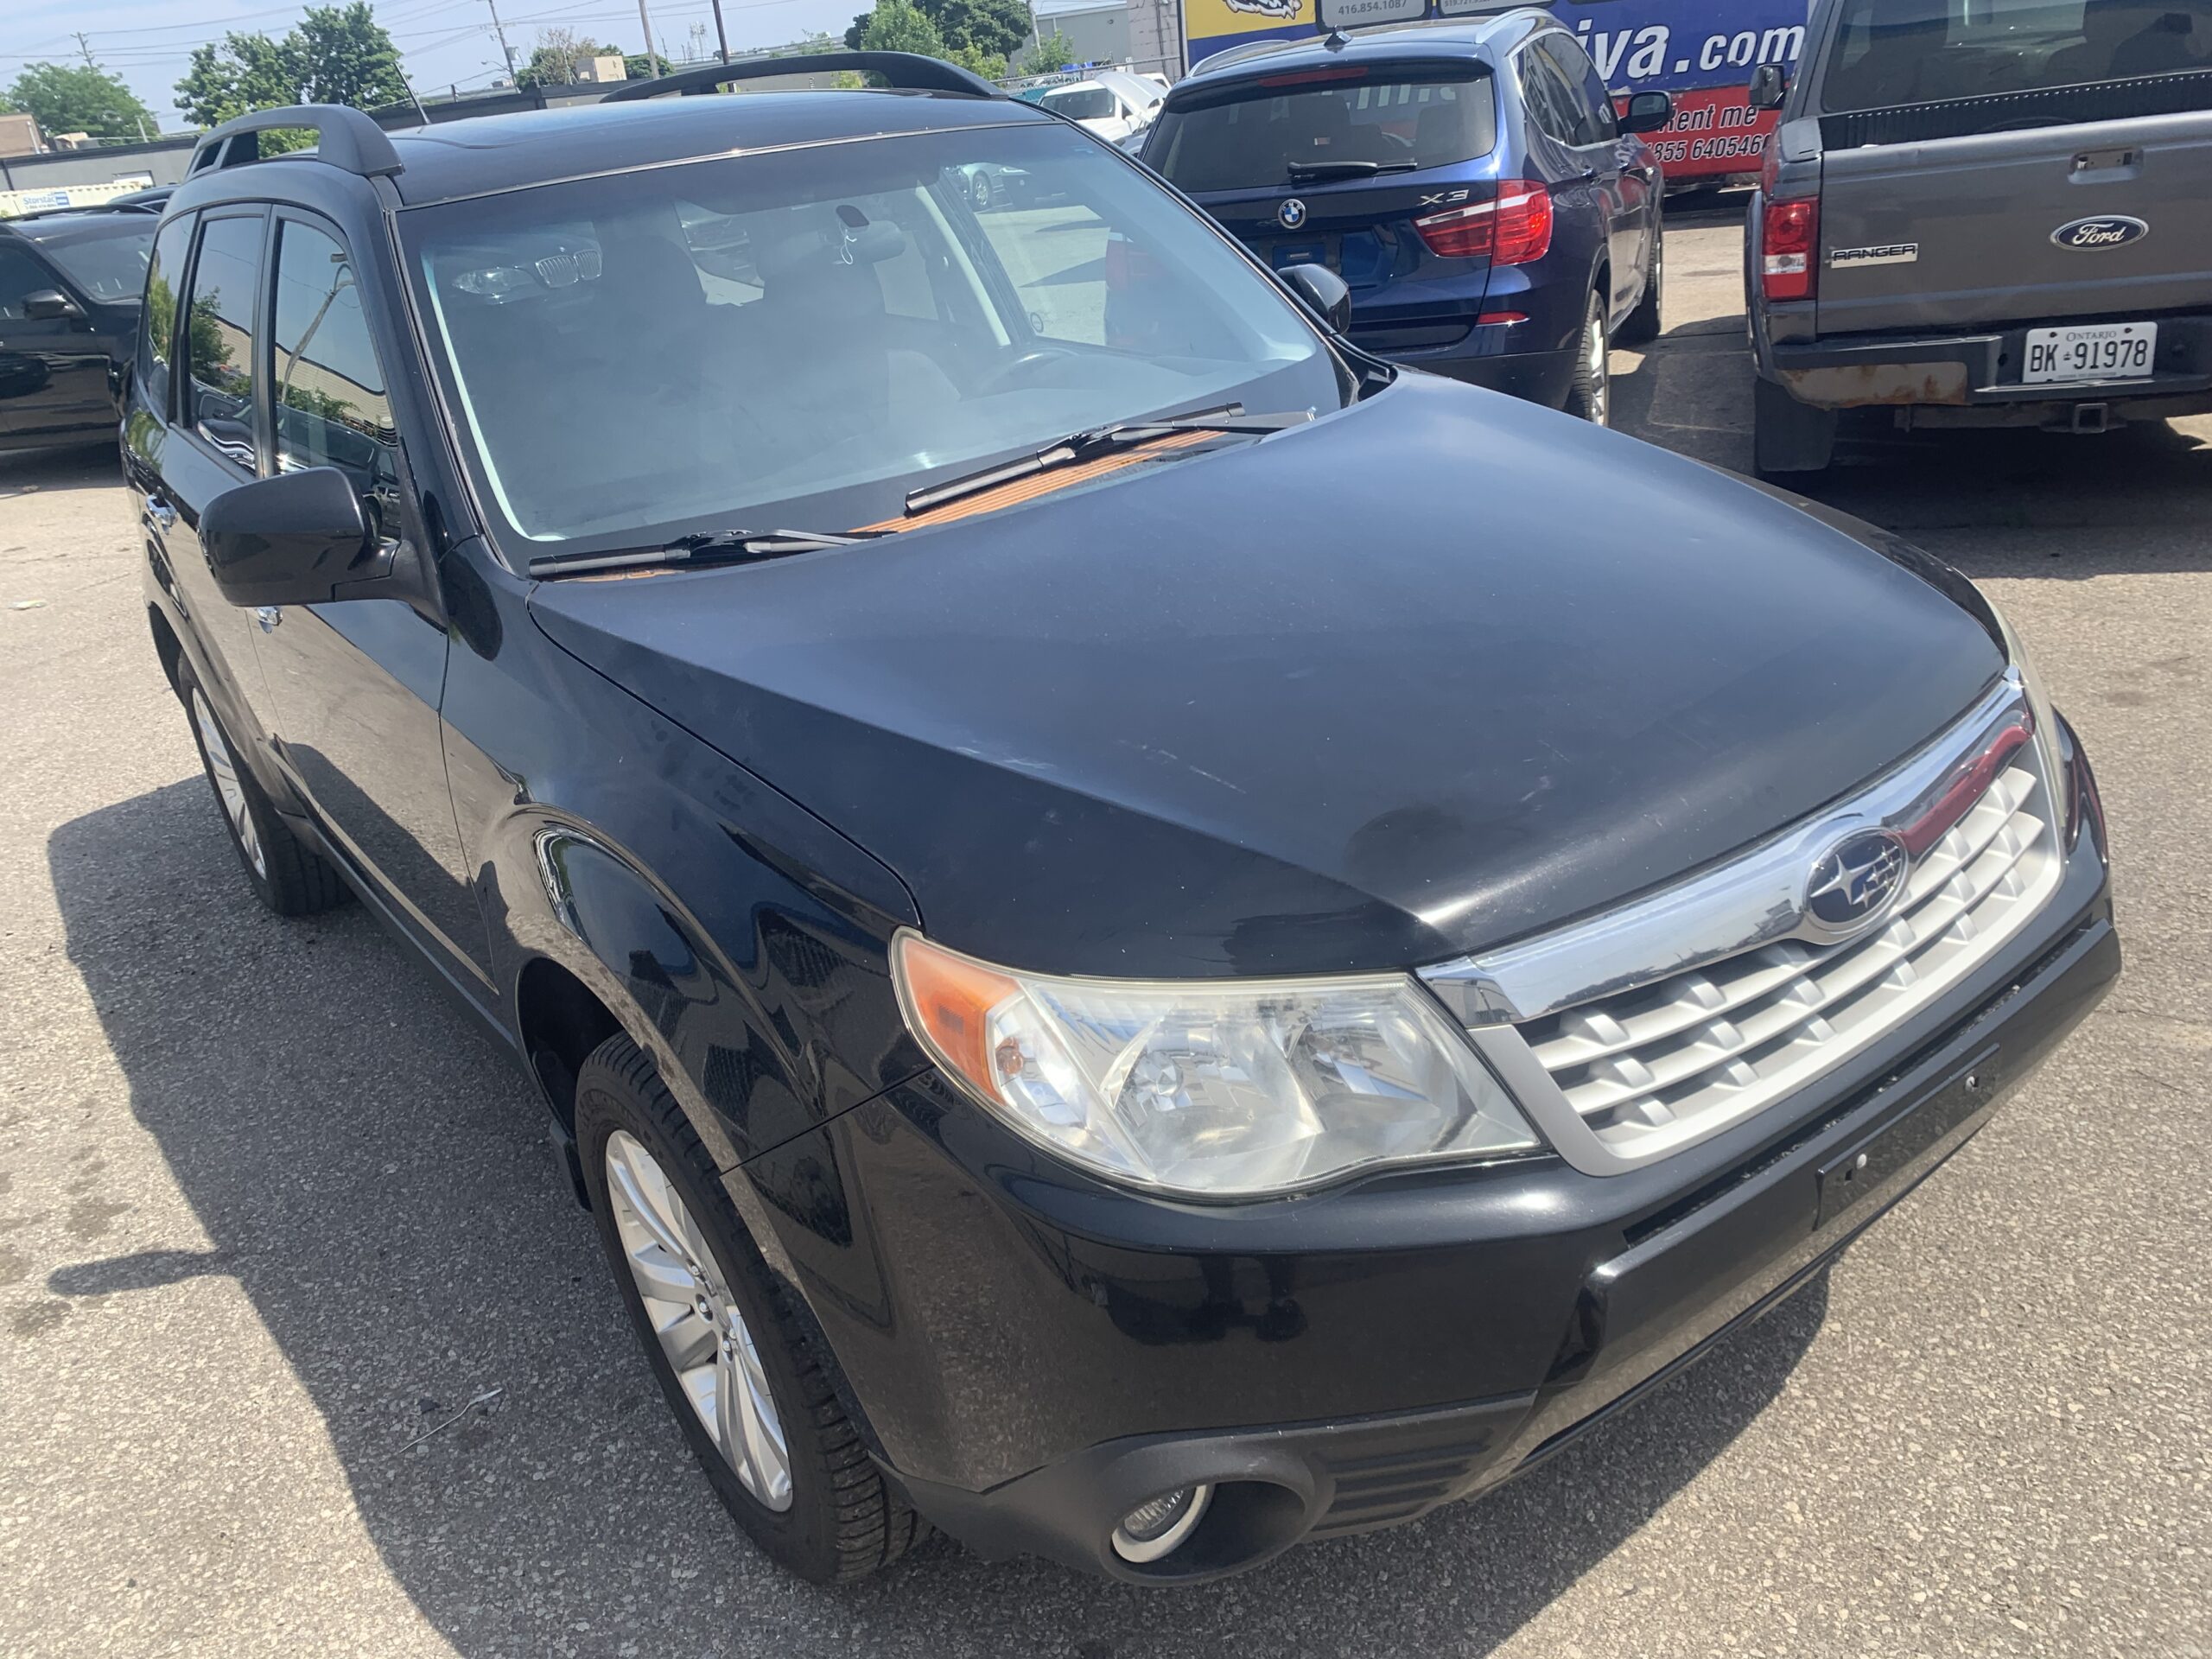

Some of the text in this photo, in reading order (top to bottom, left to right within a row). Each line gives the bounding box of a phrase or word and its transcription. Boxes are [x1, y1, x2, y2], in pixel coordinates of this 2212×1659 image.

[1719, 105, 1758, 129] me
[1649, 140, 1688, 162] 855
[1418, 189, 1469, 206] X3
[2072, 223, 2125, 245] Ford
[1832, 245, 1917, 262] RANGER
[2030, 340, 2149, 372] BK 91978
